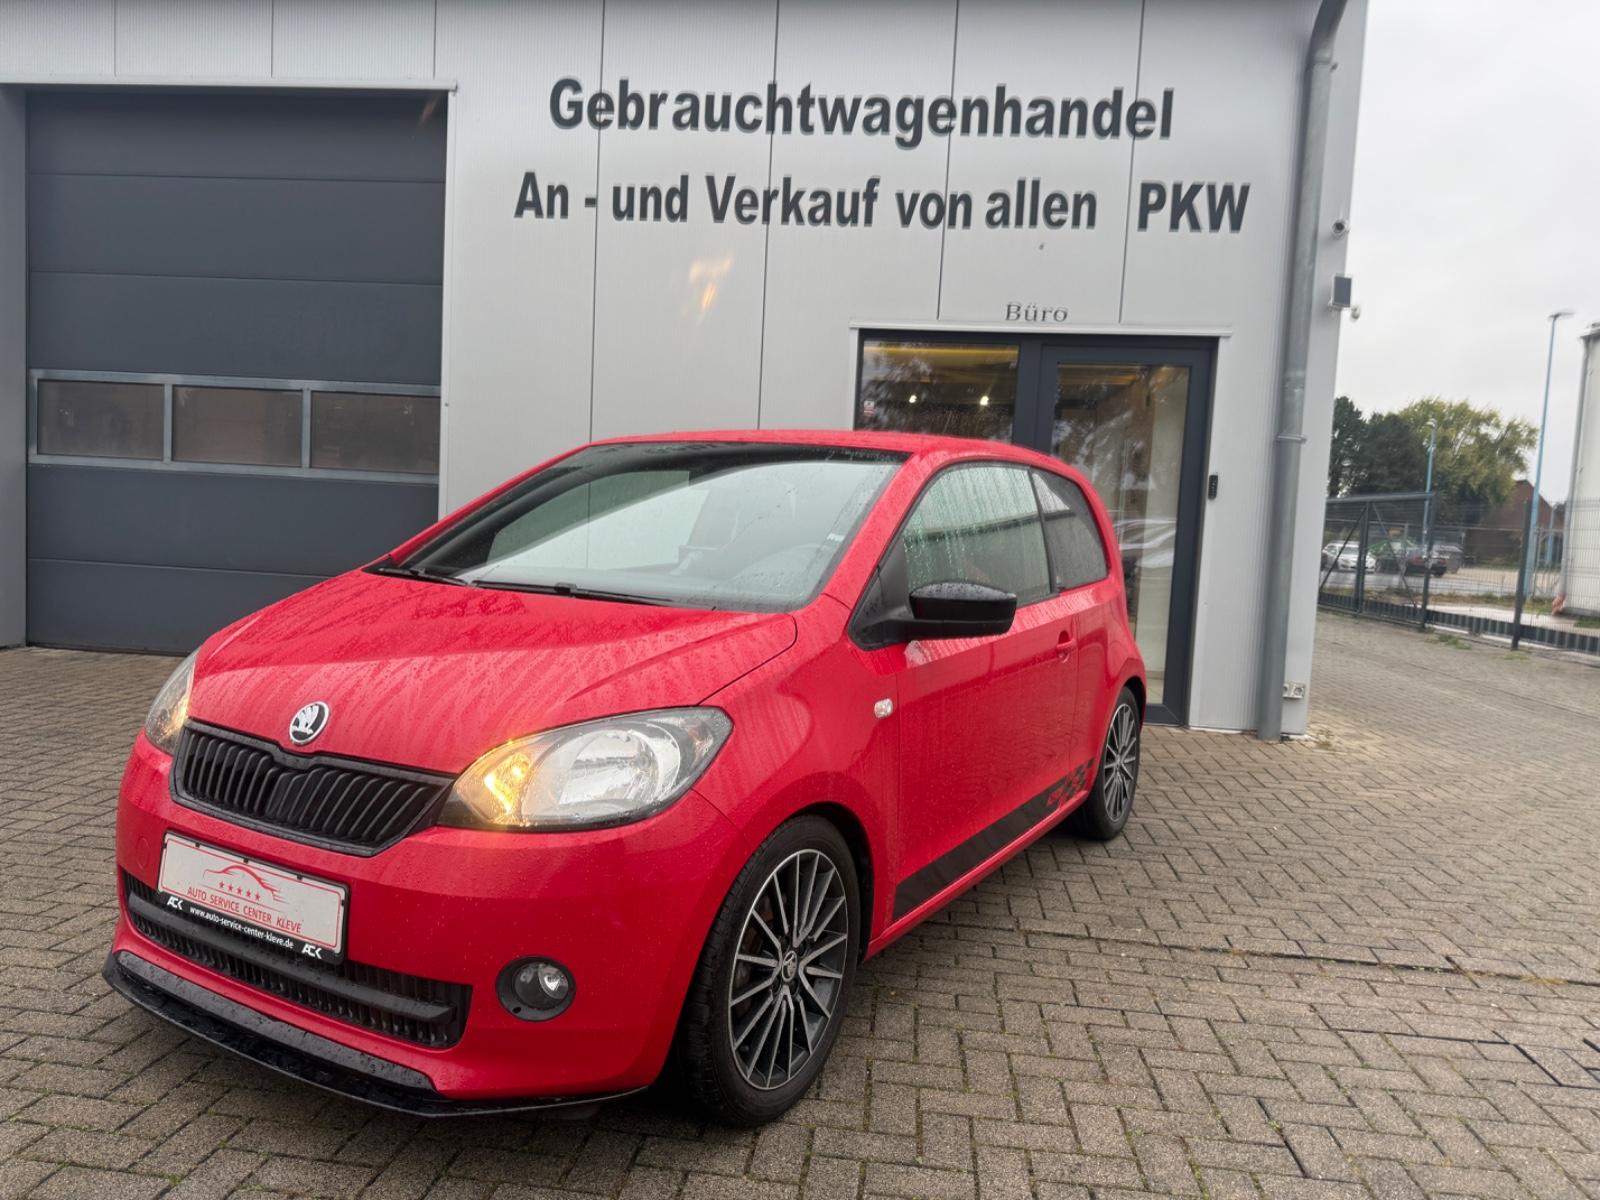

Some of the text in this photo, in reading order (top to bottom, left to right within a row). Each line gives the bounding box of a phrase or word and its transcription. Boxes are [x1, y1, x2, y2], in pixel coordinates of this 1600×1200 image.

[550, 77, 1174, 149] Gebrauchtwagenhandel
[611, 172, 689, 223] und
[705, 172, 881, 227] Verkauf
[895, 189, 973, 230] von
[984, 176, 1097, 230] allen
[1136, 180, 1251, 233] PKW
[1004, 301, 1069, 324] Büro
[187, 886, 303, 934] AUTO SERVICE CENTER KLEVE
[190, 906, 294, 948] www.auto-service-center-kleve.de
